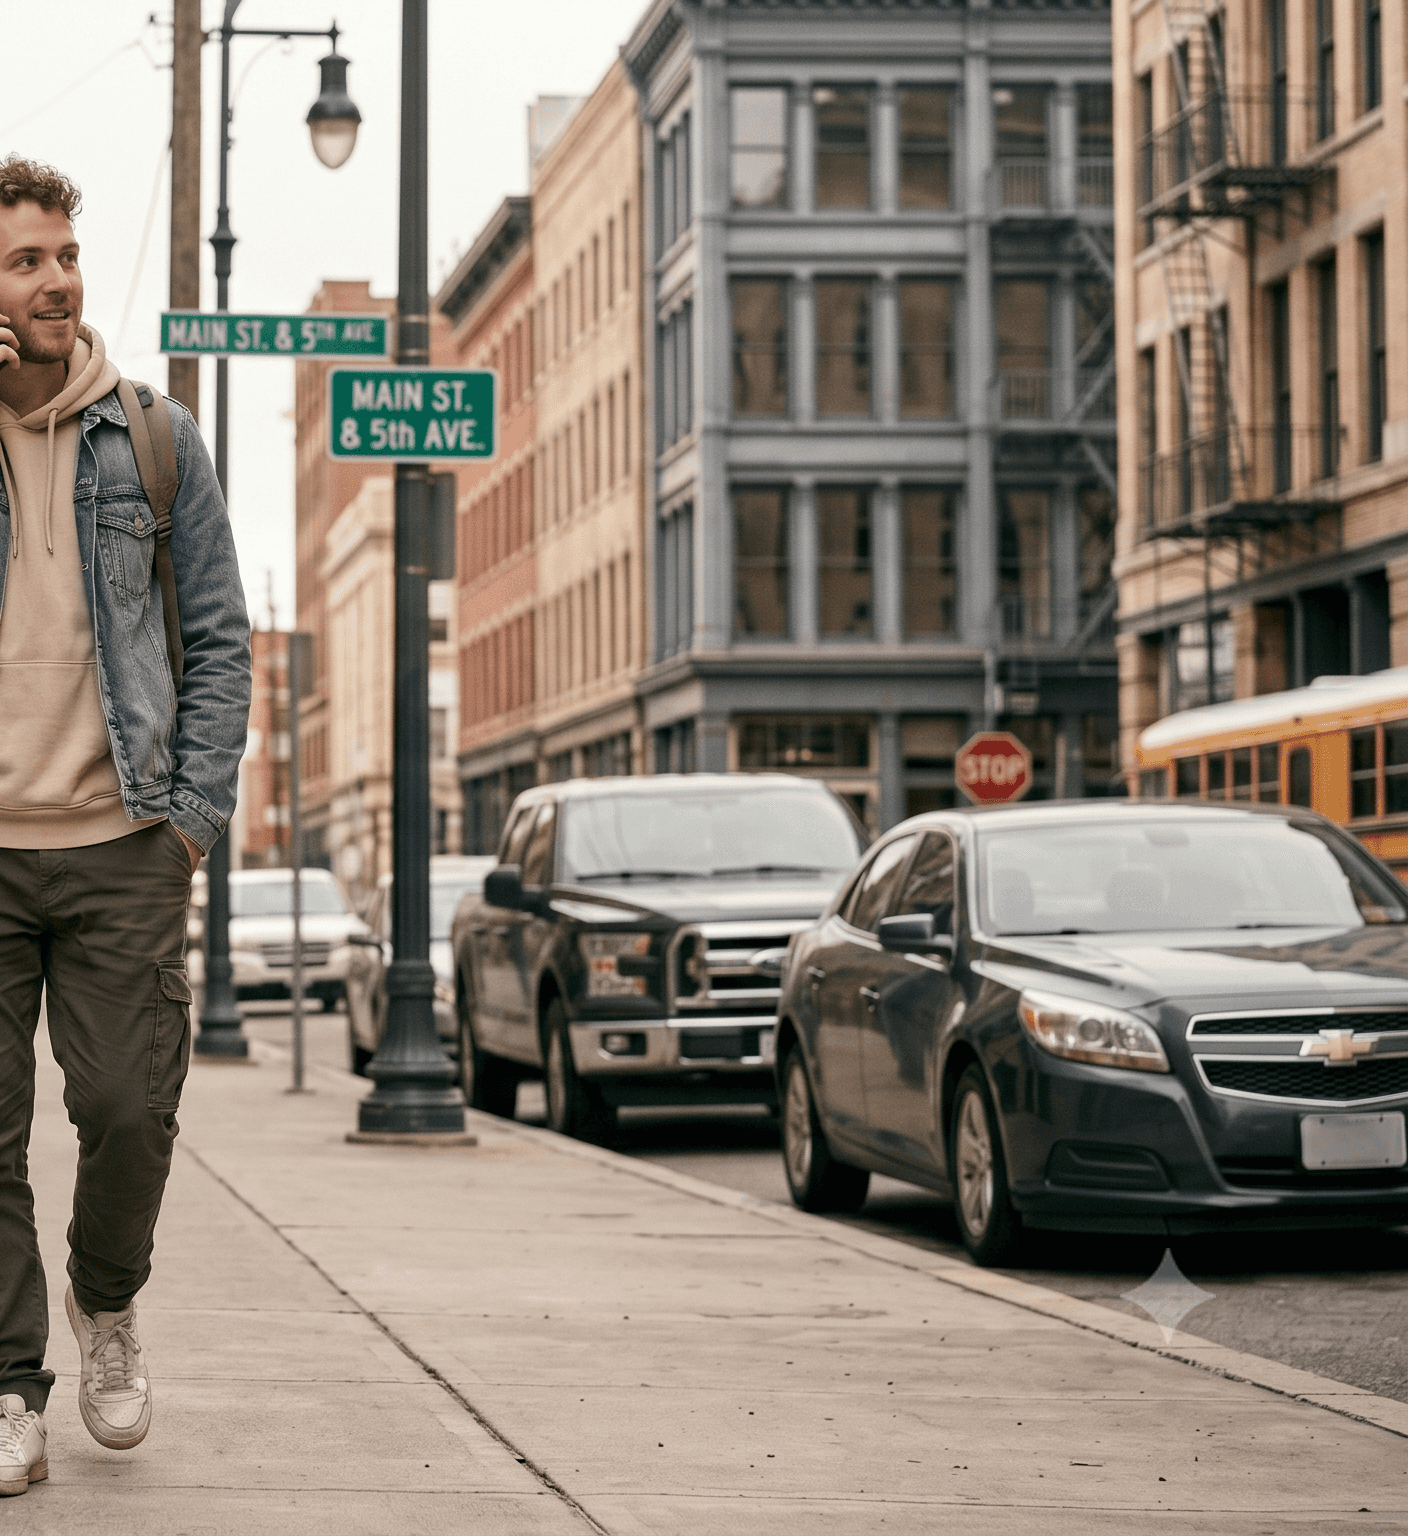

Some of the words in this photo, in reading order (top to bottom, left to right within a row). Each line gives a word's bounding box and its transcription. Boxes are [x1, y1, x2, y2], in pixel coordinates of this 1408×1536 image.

[168, 319, 227, 349] MAIN
[235, 320, 269, 351] ST.
[275, 320, 294, 351] &
[352, 380, 424, 411] MAIN
[431, 380, 474, 413] ST.
[340, 418, 361, 450] &
[369, 418, 416, 450] 5th
[422, 419, 486, 451] AVE.
[962, 754, 1025, 784] STOP
